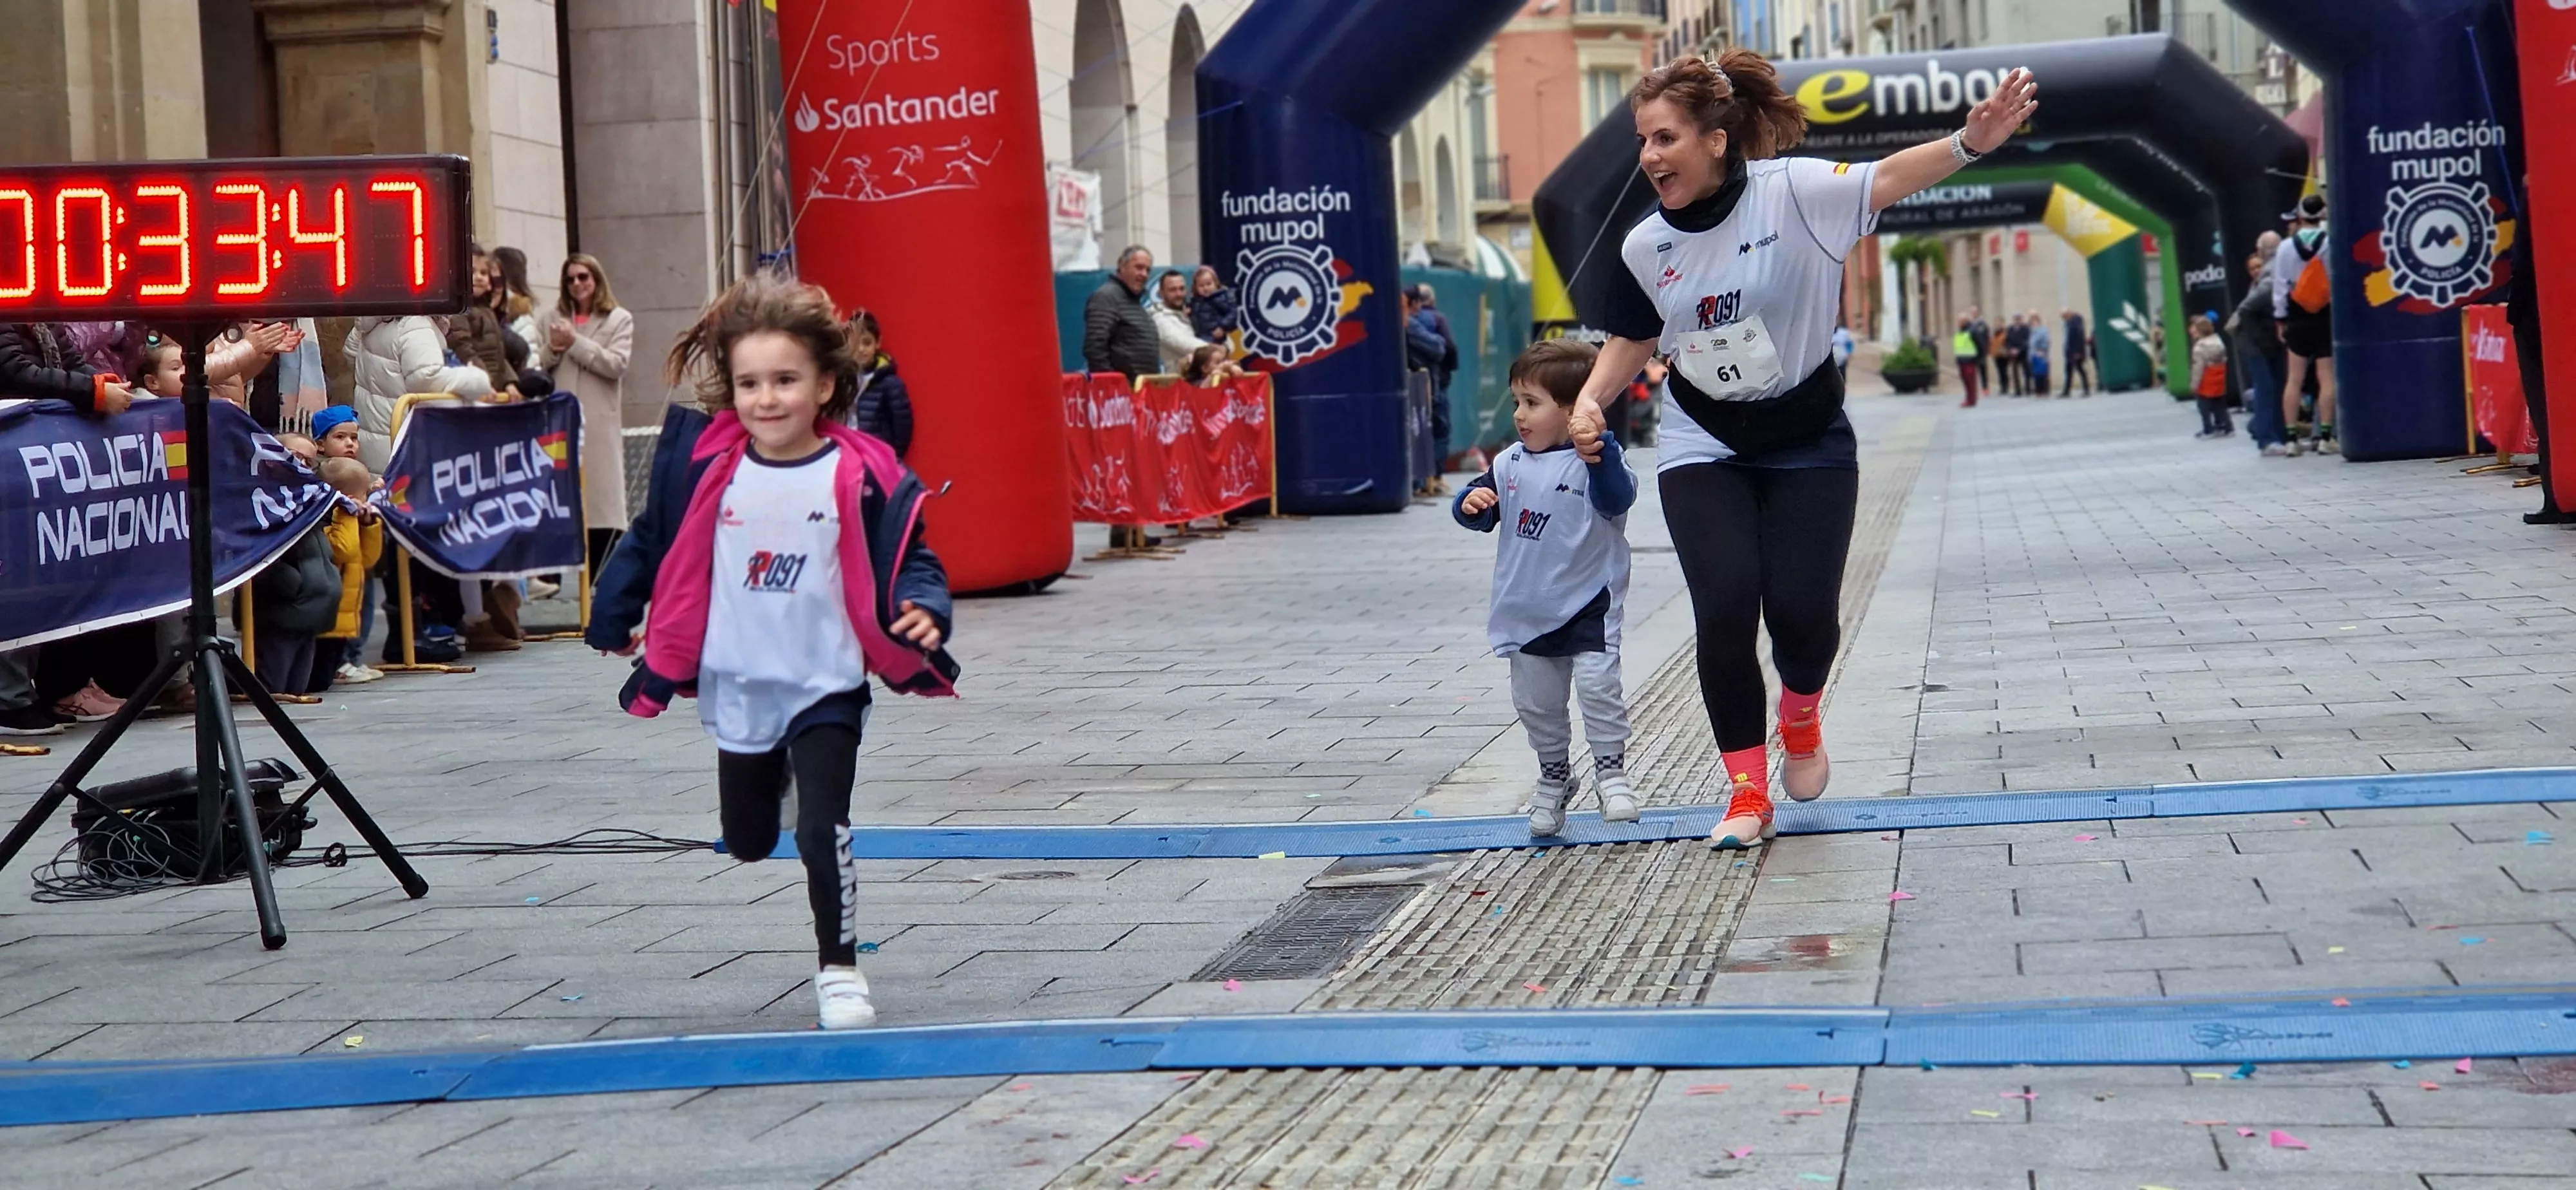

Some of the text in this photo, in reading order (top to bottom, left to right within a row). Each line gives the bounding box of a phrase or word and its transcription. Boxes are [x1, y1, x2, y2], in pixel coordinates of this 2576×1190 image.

[827, 31, 940, 76] Sports
[824, 86, 998, 129] Santander
[2367, 119, 2505, 153] fundación
[2392, 149, 2481, 182] mupol
[1222, 185, 1350, 218] fundación
[1241, 212, 1324, 245] mupol
[1755, 230, 1779, 250] mupol
[1717, 363, 1742, 382] 61
